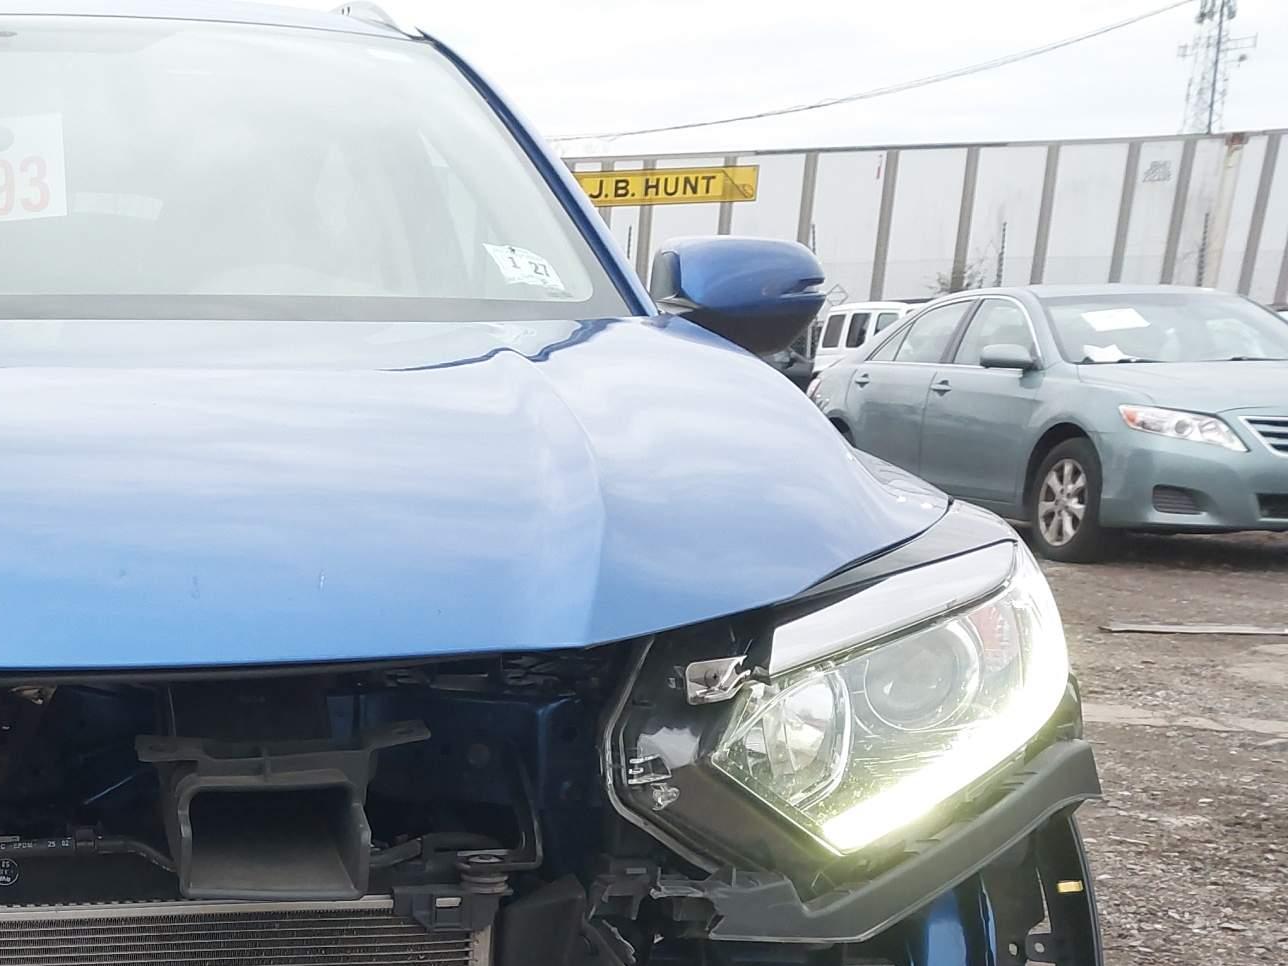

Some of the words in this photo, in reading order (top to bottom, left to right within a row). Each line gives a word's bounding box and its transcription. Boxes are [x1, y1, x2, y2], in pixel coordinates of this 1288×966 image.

[588, 179, 636, 199] J.B.
[643, 175, 717, 197] HUNT
[507, 256, 521, 269] 1
[528, 261, 551, 277] 27
